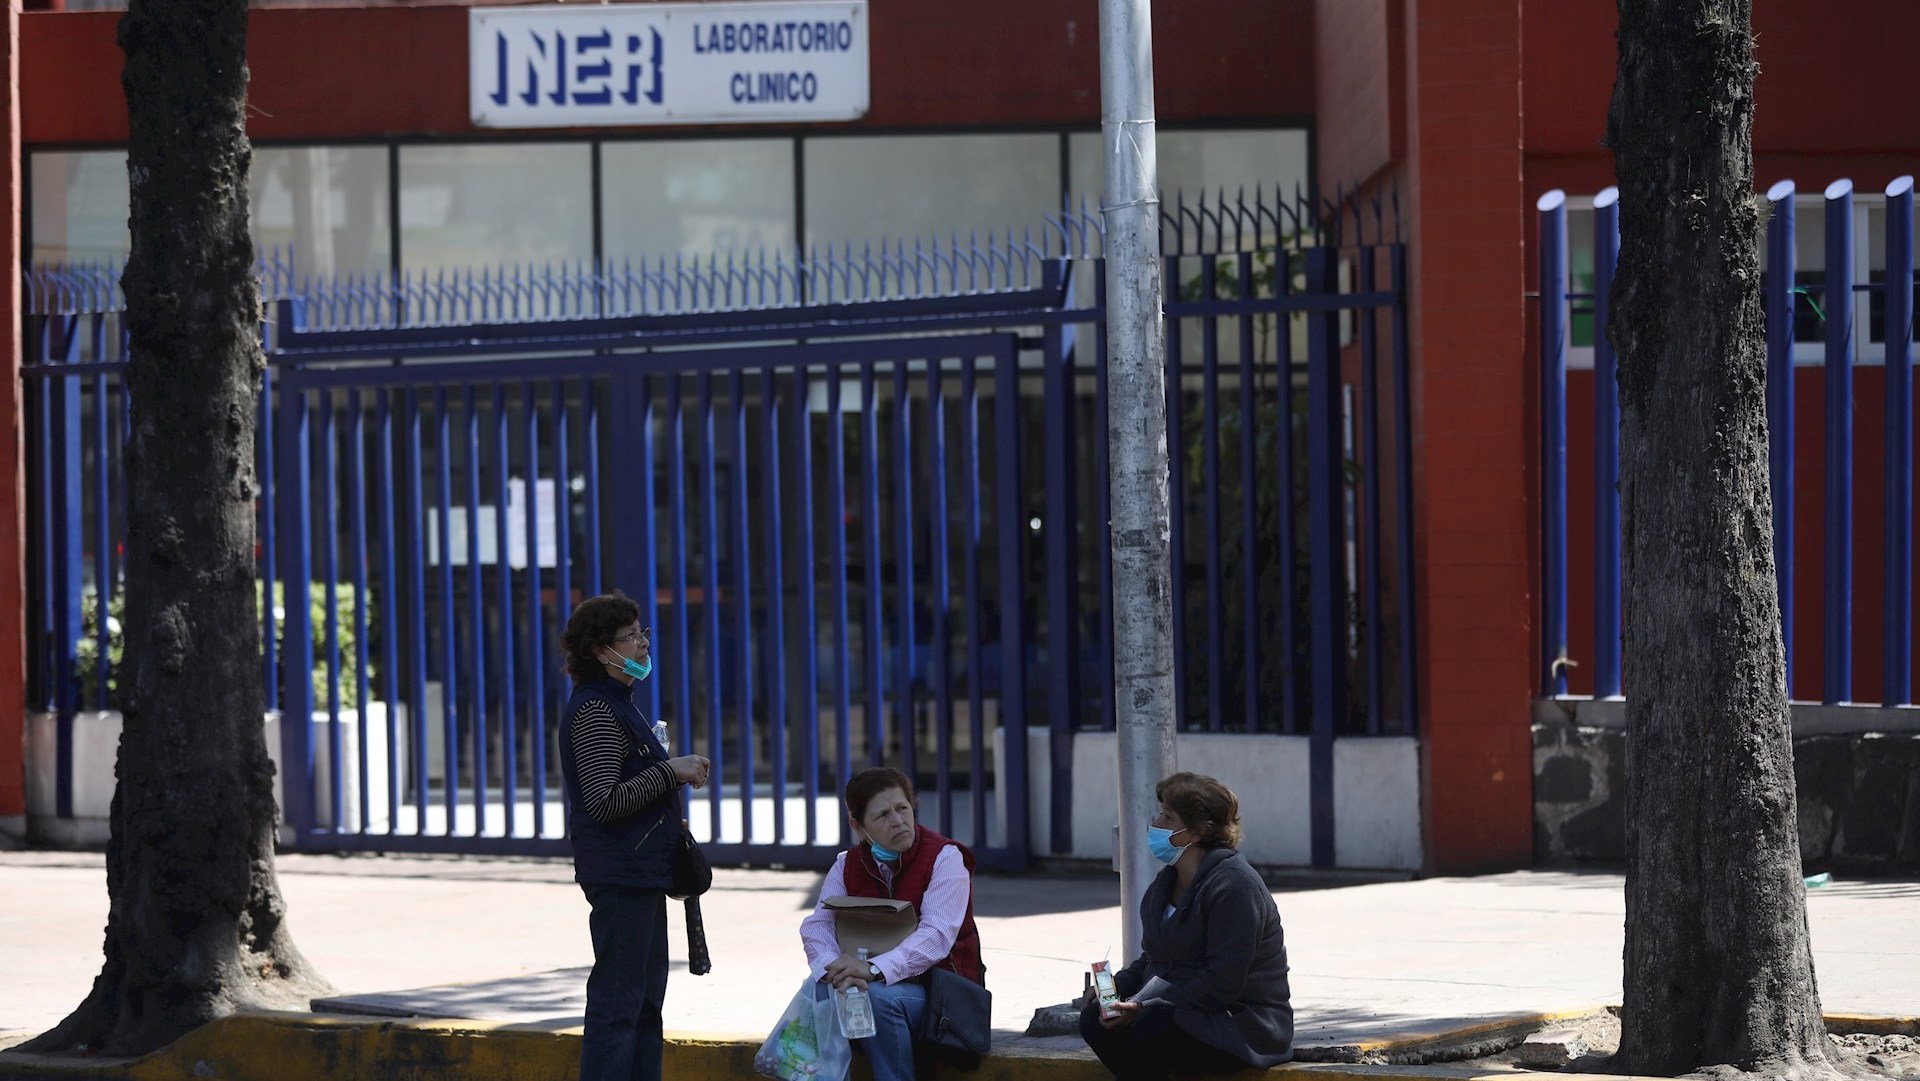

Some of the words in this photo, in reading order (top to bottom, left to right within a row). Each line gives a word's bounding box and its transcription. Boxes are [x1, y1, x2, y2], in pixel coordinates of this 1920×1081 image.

[693, 21, 852, 54] LABORATORIO
[489, 26, 663, 106] INER
[730, 72, 818, 103] CLINICO
